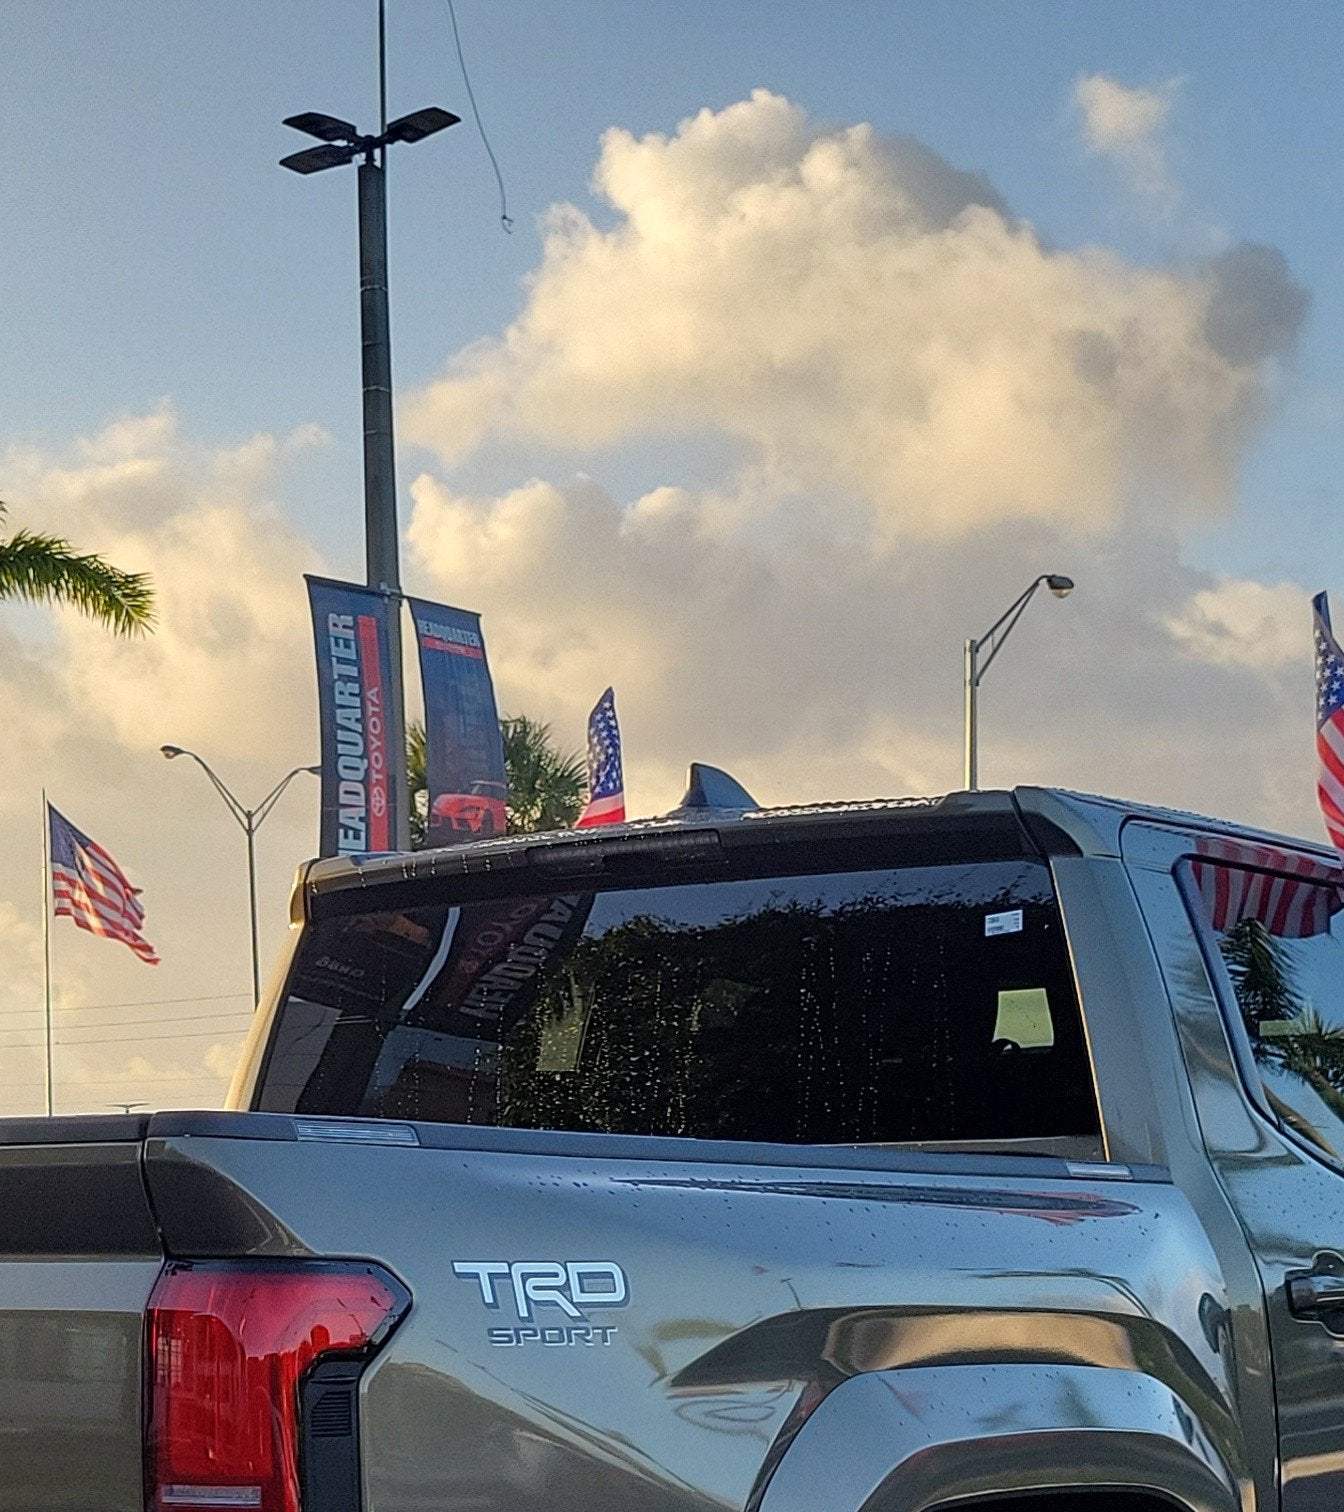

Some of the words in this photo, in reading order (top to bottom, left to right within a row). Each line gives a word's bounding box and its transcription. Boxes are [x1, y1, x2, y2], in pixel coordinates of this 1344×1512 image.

[365, 686, 386, 784] TOYOTA
[452, 1260, 630, 1323] TRD
[487, 1326, 619, 1348] SPORT
